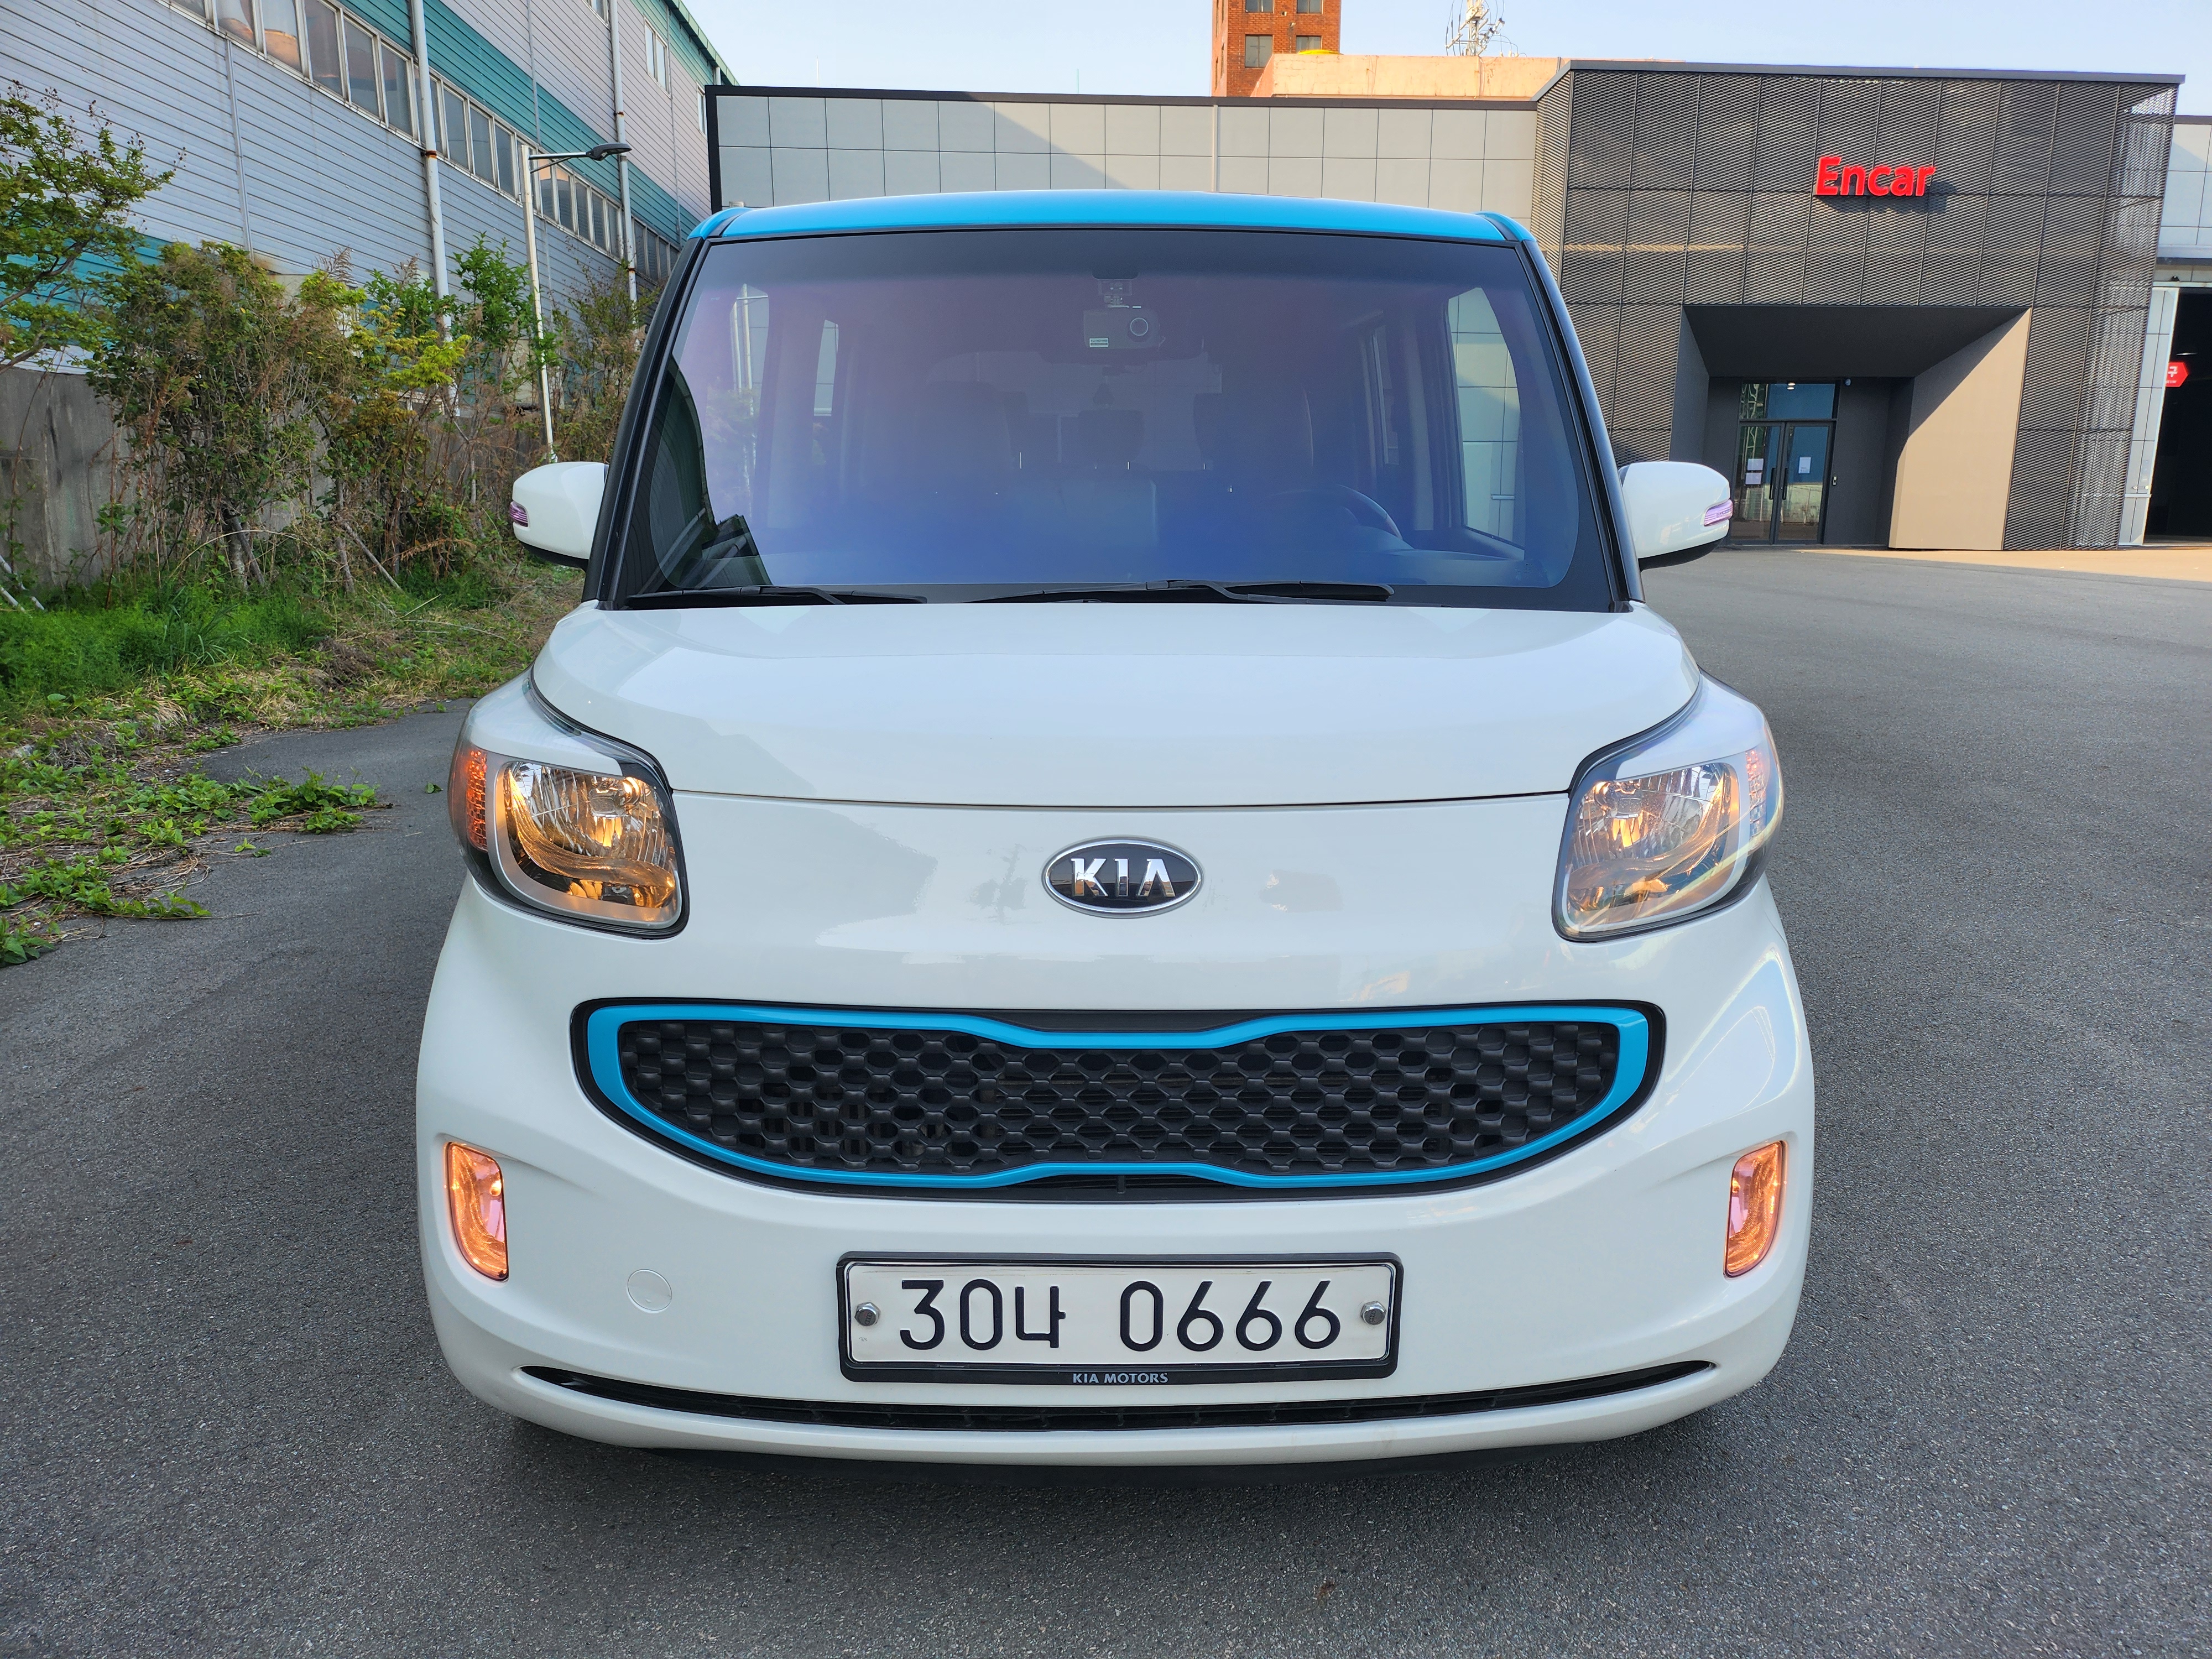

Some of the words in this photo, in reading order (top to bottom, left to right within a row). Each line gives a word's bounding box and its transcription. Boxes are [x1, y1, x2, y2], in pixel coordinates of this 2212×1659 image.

[1815, 156, 1936, 196] Encar
[1070, 858, 1176, 898] KIA
[900, 1279, 1066, 1351] 30나
[1120, 1280, 1341, 1352] 0666
[1073, 1373, 1099, 1384] KIA
[1104, 1373, 1169, 1384] MOTORS
